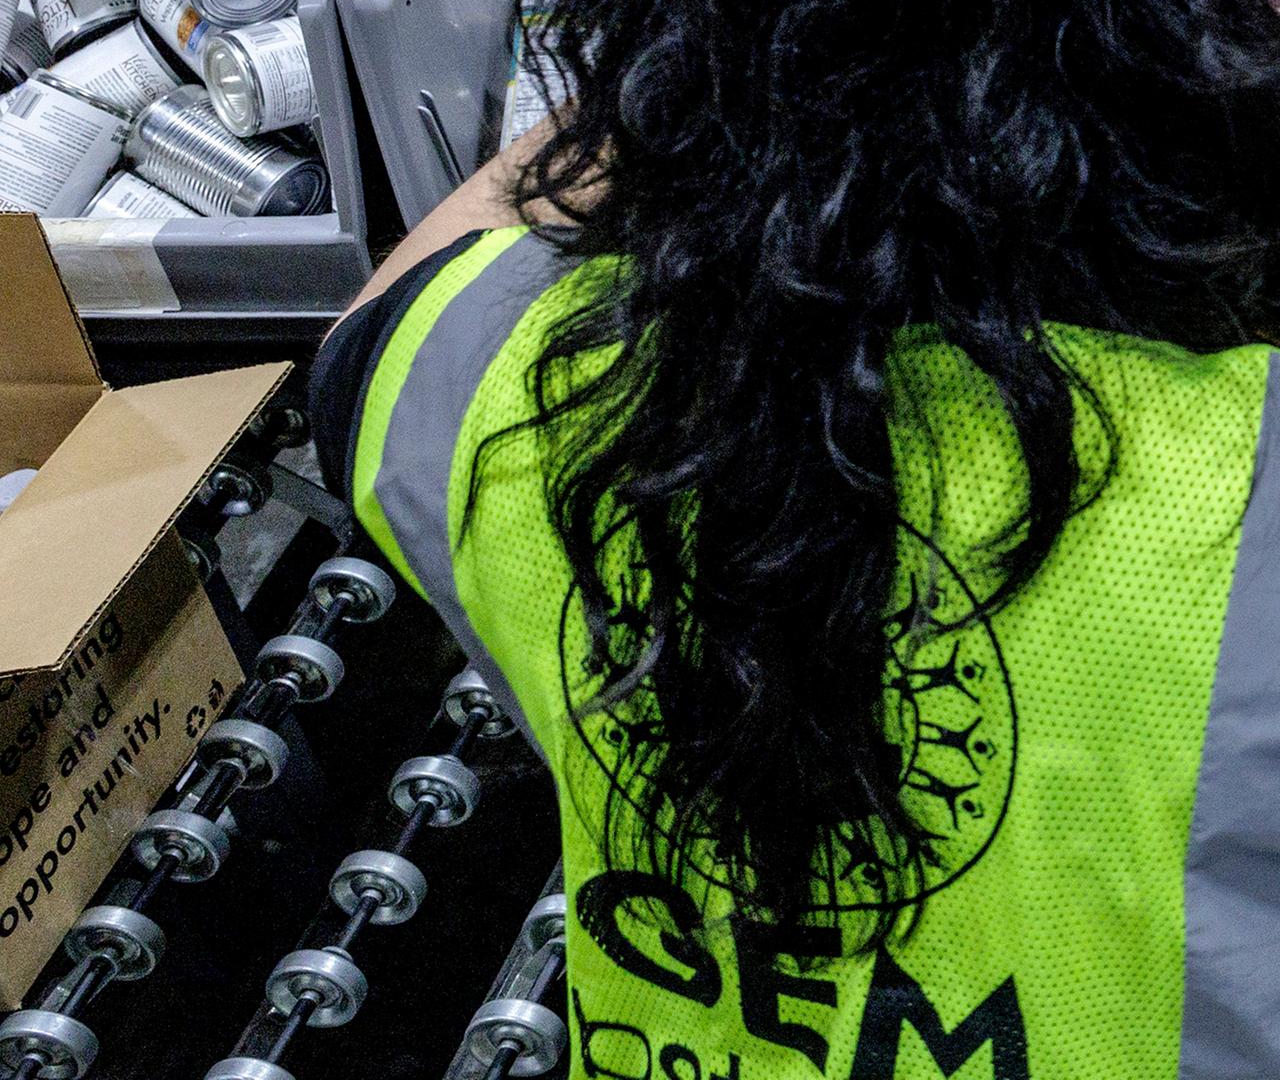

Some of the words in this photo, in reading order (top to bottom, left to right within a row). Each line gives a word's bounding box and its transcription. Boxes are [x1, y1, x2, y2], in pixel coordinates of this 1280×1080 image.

[121, 57, 157, 101] KITCHEN
[0, 782, 51, 866] ope
[58, 682, 116, 778] and
[0, 698, 171, 938] opportunity.
[575, 868, 1034, 1080] GEM
